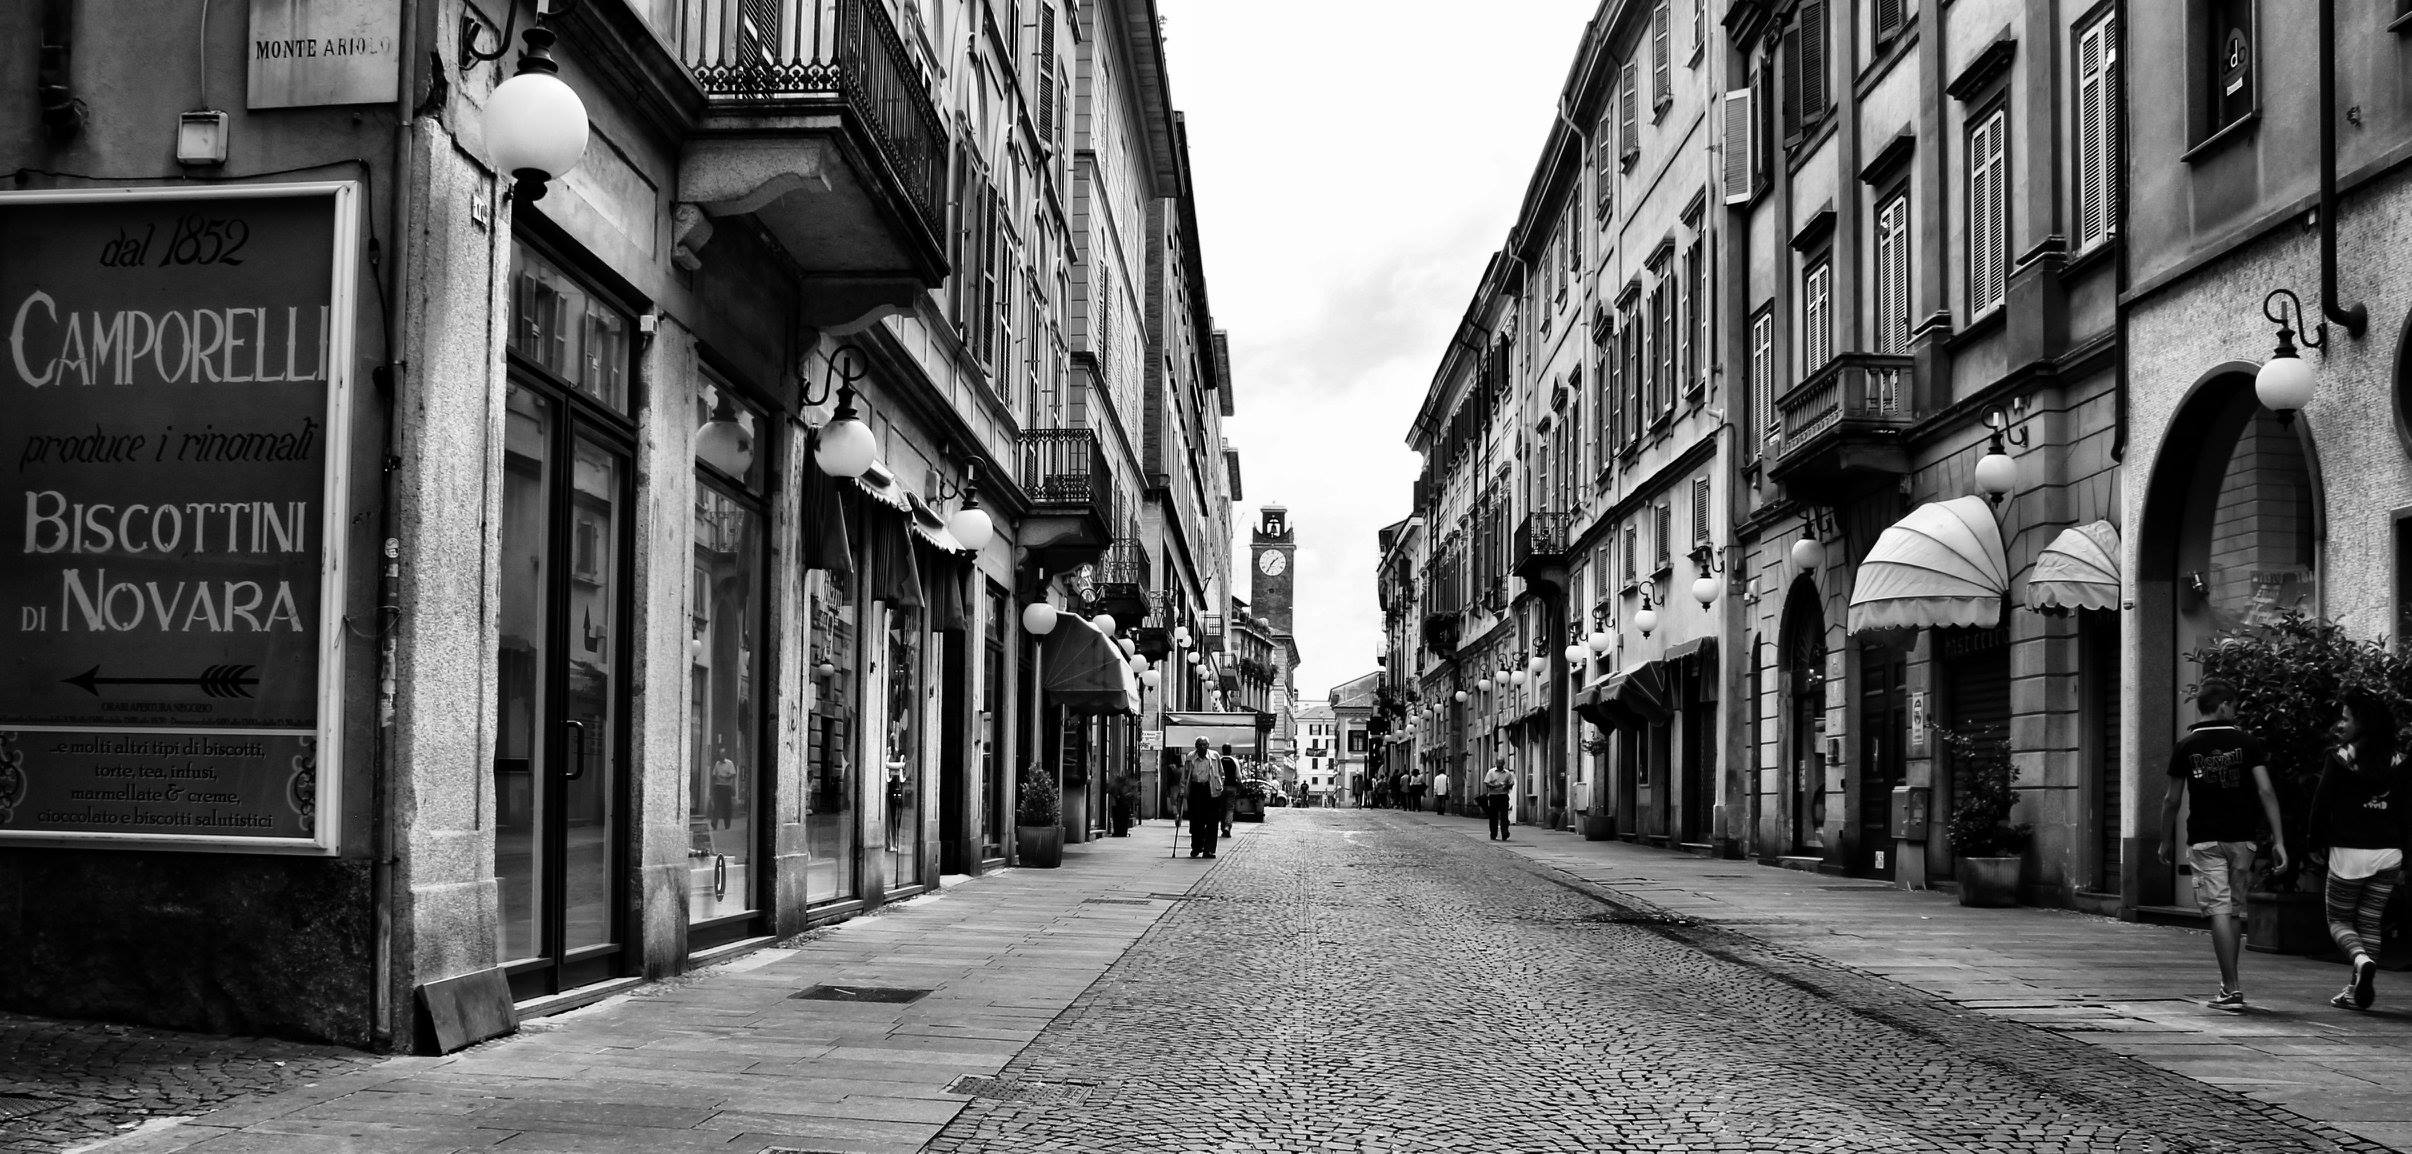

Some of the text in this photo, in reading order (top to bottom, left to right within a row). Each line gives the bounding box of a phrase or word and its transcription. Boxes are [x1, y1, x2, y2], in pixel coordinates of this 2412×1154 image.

[255, 38, 317, 60] MONTE
[99, 214, 250, 268] dal 1852
[9, 289, 330, 389] CAMPORELLI
[19, 423, 146, 473] produce
[155, 425, 173, 462] i
[23, 490, 307, 554] BISCOTTINI
[21, 568, 304, 632] DI NOVARA
[71, 737, 112, 755] molti
[114, 737, 149, 755] altri
[152, 738, 180, 760] tipi
[182, 738, 200, 755] di
[203, 738, 267, 759] biscotti,
[95, 762, 219, 781] torte, tea, infusi,
[71, 783, 241, 805] marmellate & creme,
[37, 806, 274, 829] cioccolato e biscotti salutistici
